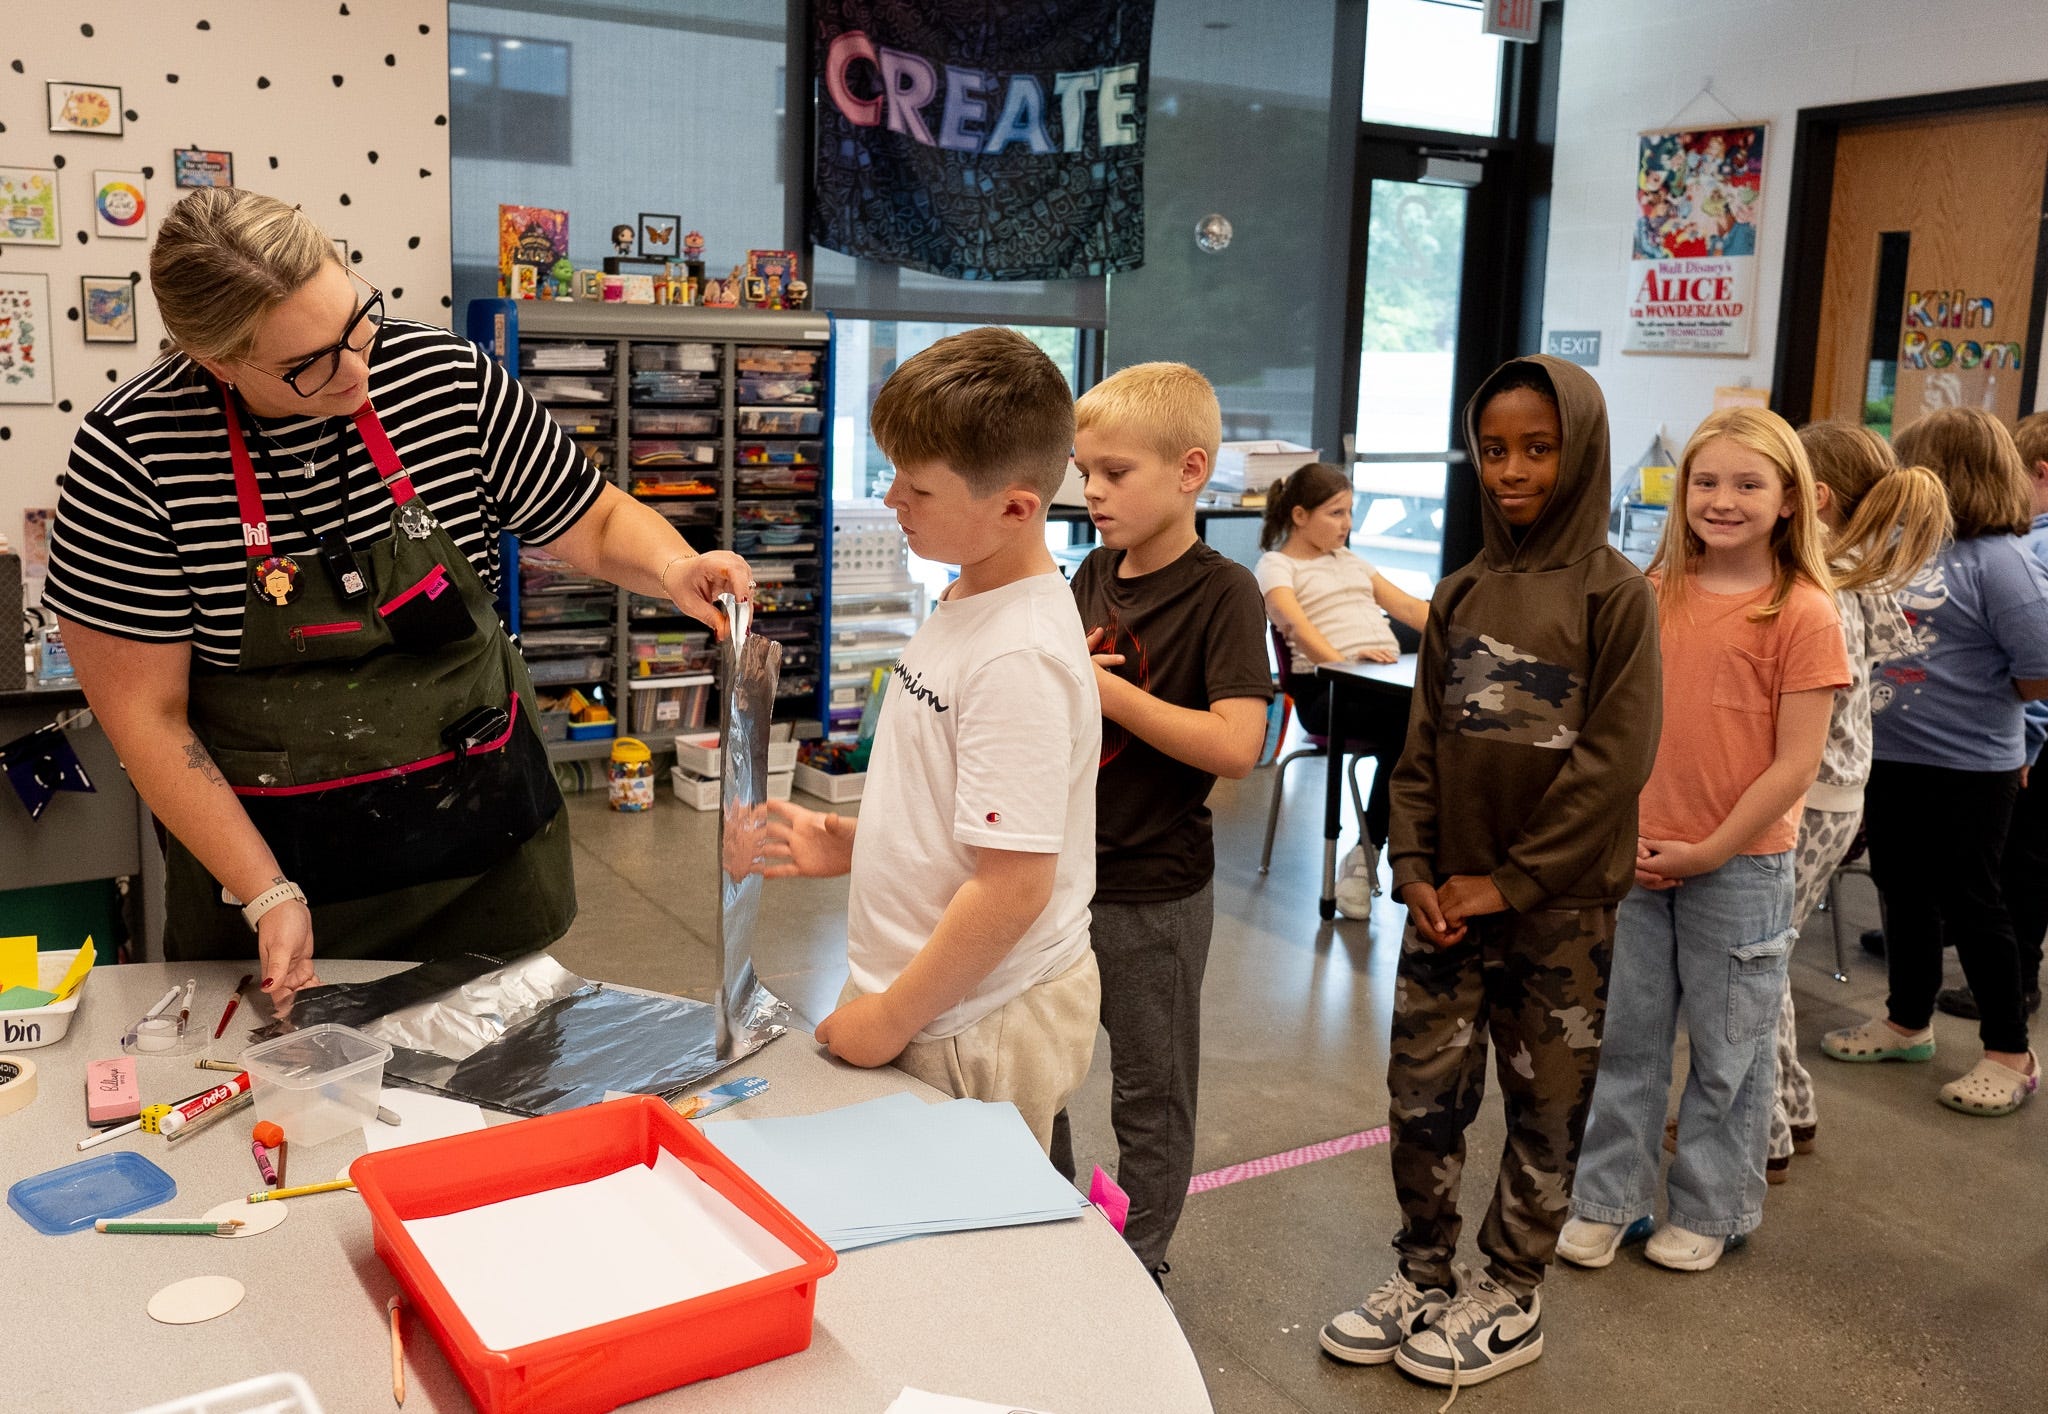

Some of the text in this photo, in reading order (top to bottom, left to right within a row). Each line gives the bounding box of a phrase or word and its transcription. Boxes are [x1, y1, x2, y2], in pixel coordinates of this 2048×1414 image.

[826, 30, 1139, 154] CREATE
[1659, 261, 1732, 275] Walt Disney's
[1636, 269, 1732, 302] ALICE
[1646, 303, 1743, 318] WONDERLAND
[1907, 289, 1994, 328] Kiln
[1561, 337, 1598, 354] EXIT
[1903, 331, 2021, 369] Room
[242, 522, 269, 546] hi
[4, 1019, 41, 1043] bin
[742, 1082, 770, 1098] wich
